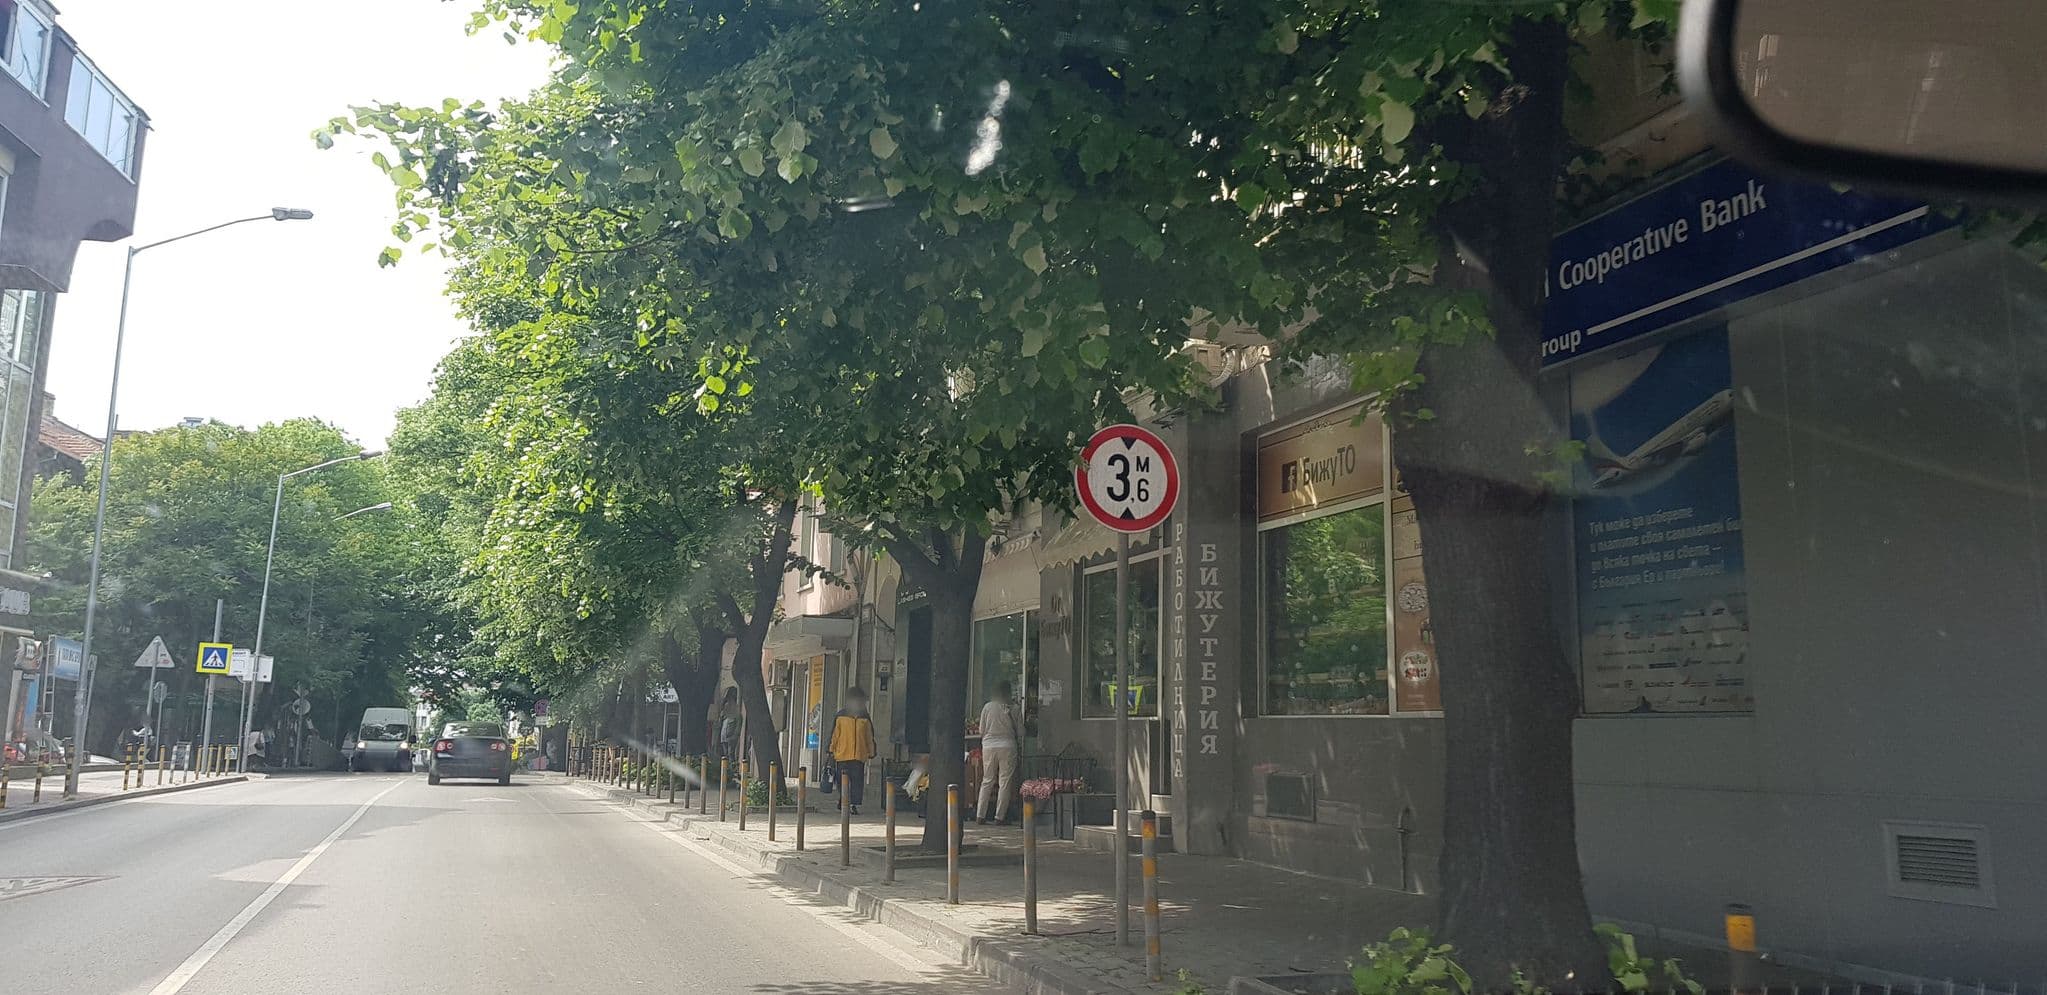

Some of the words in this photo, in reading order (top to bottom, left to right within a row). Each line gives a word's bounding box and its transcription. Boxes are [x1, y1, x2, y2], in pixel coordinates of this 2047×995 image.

[1559, 218, 1689, 289] Cooperative
[1700, 179, 1768, 233] Bank
[1542, 329, 1581, 357] roup
[1174, 522, 1184, 778] РАБОТИЛНИЦА
[1195, 543, 1224, 754] БИЖУТЕРИЯ
